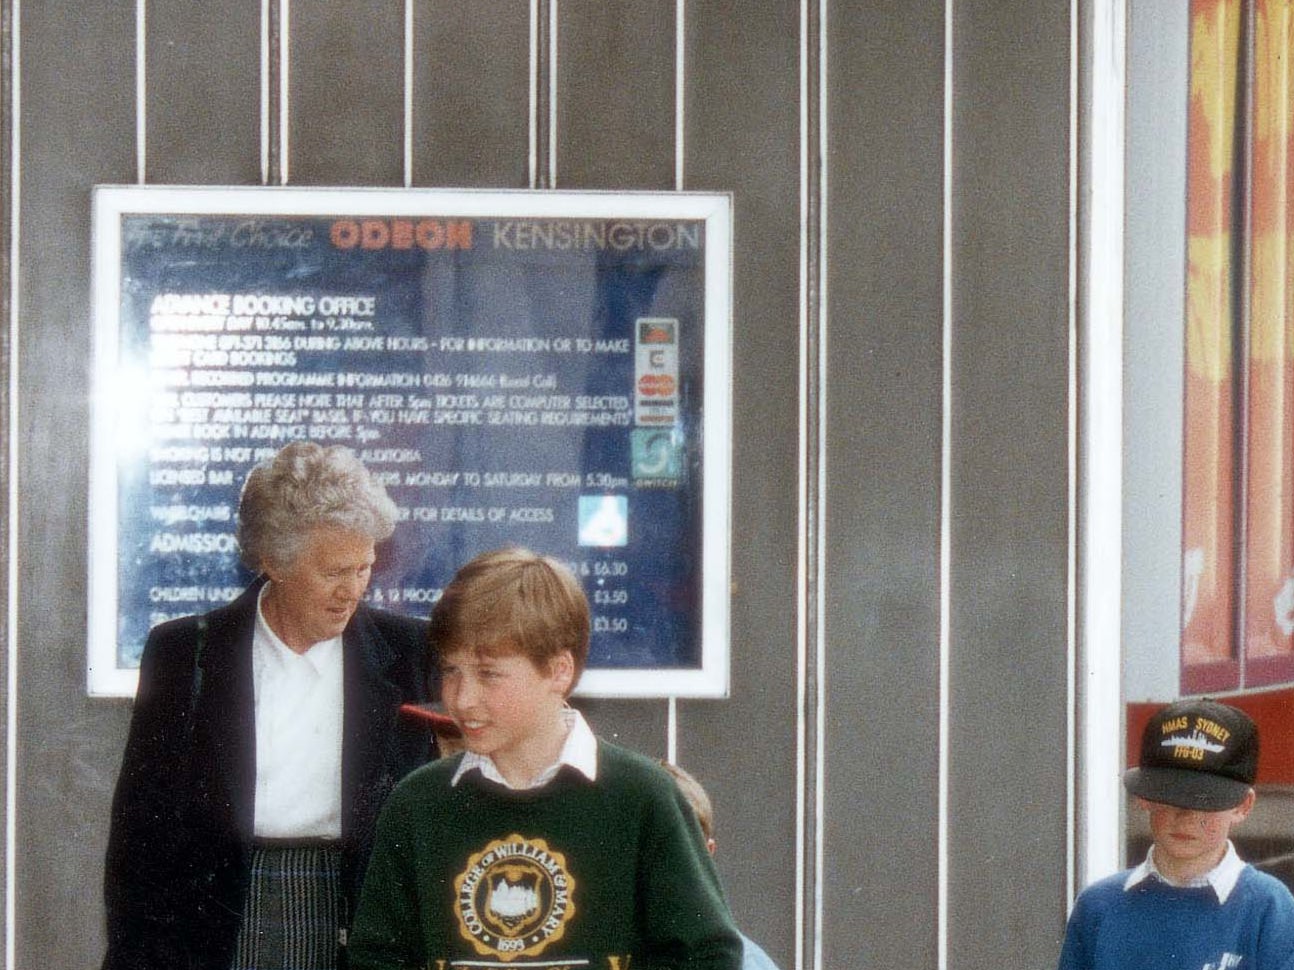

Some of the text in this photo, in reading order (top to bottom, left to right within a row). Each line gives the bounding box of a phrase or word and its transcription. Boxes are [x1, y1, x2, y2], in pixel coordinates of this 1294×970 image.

[492, 222, 700, 250] KENSINGTON
[318, 297, 376, 316] OFFICE
[595, 337, 631, 353] MAKE
[1195, 717, 1231, 743] SYDNEY
